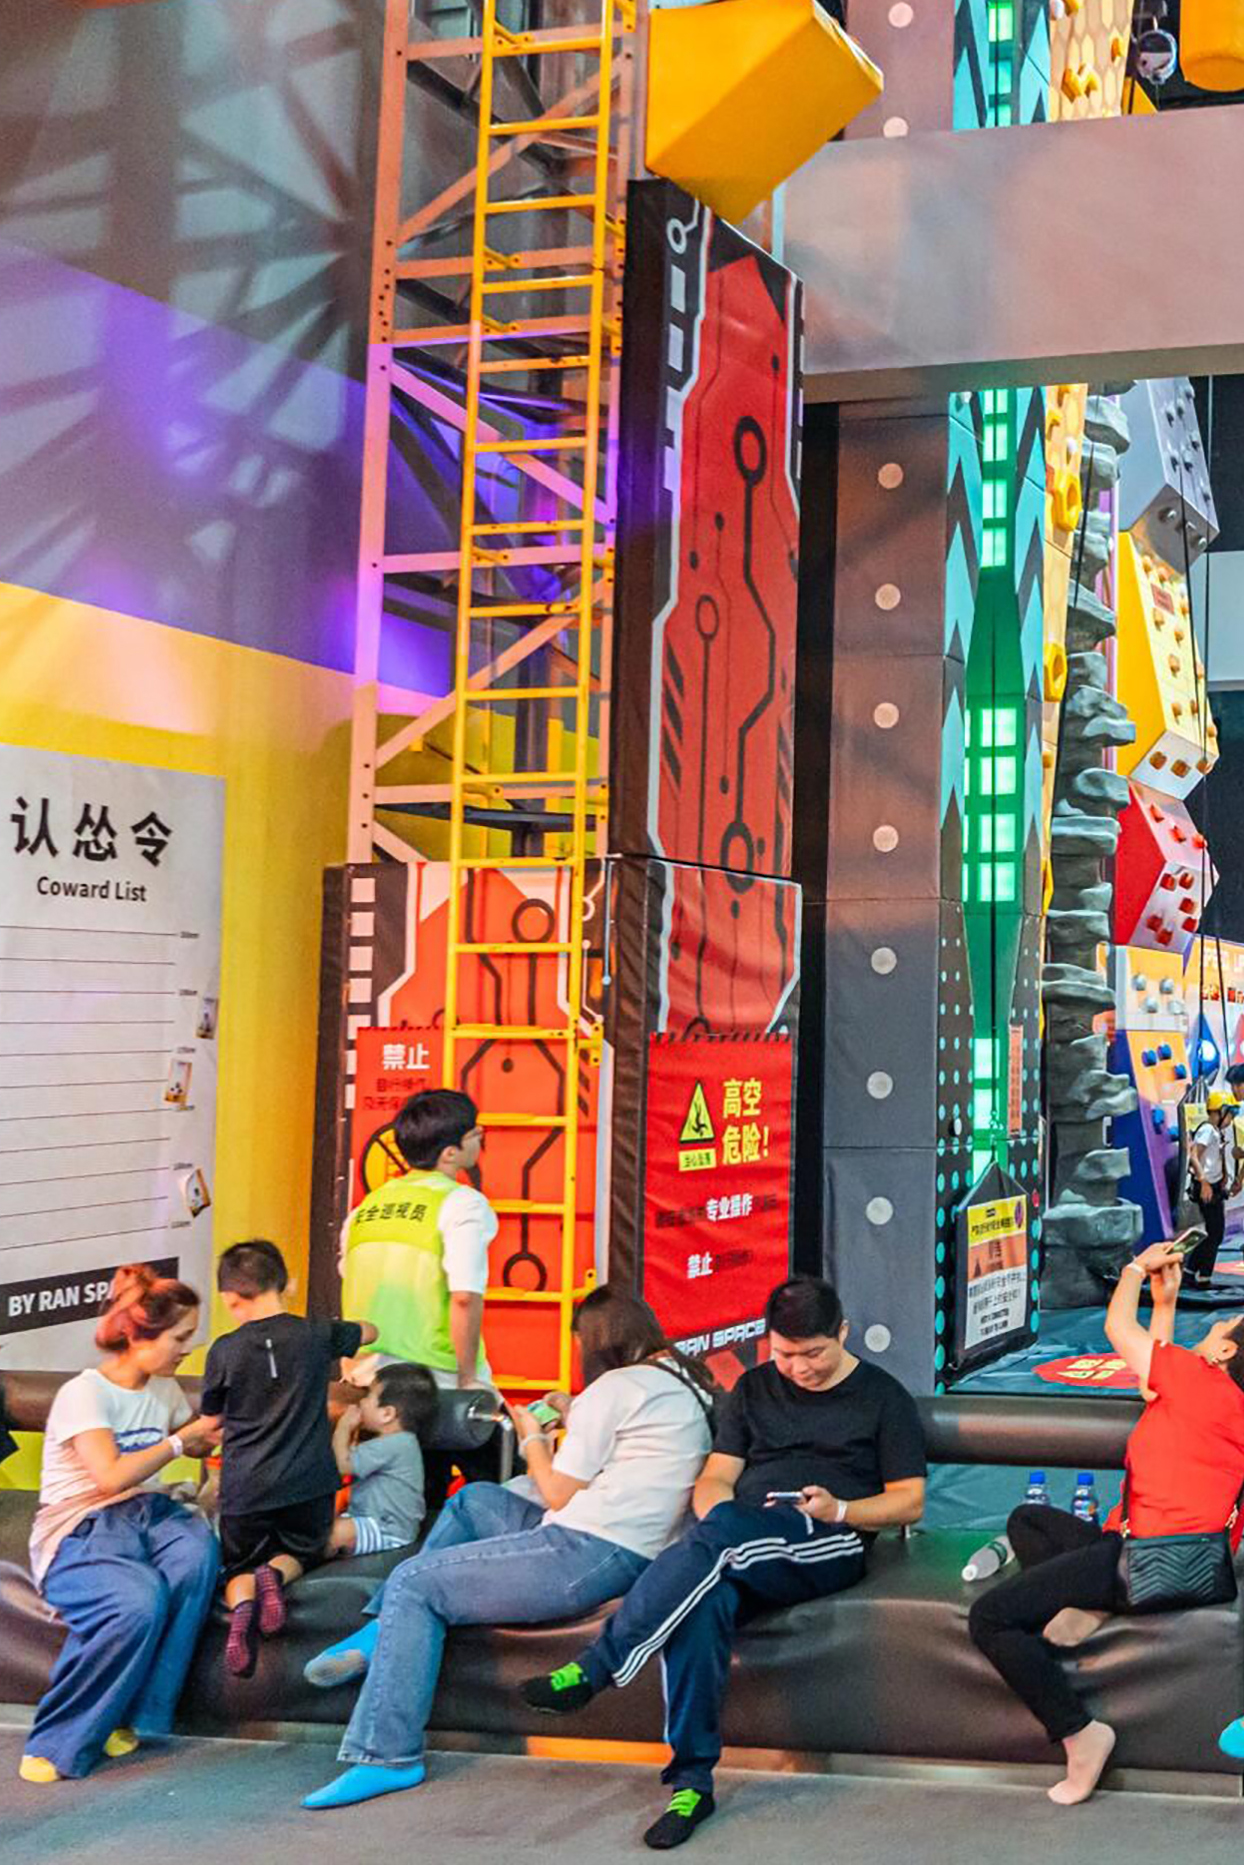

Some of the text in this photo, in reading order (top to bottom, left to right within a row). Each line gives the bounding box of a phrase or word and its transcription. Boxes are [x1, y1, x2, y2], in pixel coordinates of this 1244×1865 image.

[11, 796, 172, 867] 认怂令
[37, 876, 147, 902] Coward List
[382, 1044, 430, 1071] 禁止
[722, 1077, 762, 1119] 高空
[8, 1292, 35, 1317] BY
[38, 1286, 79, 1312] RAN
[712, 1318, 766, 1348] SPACE
